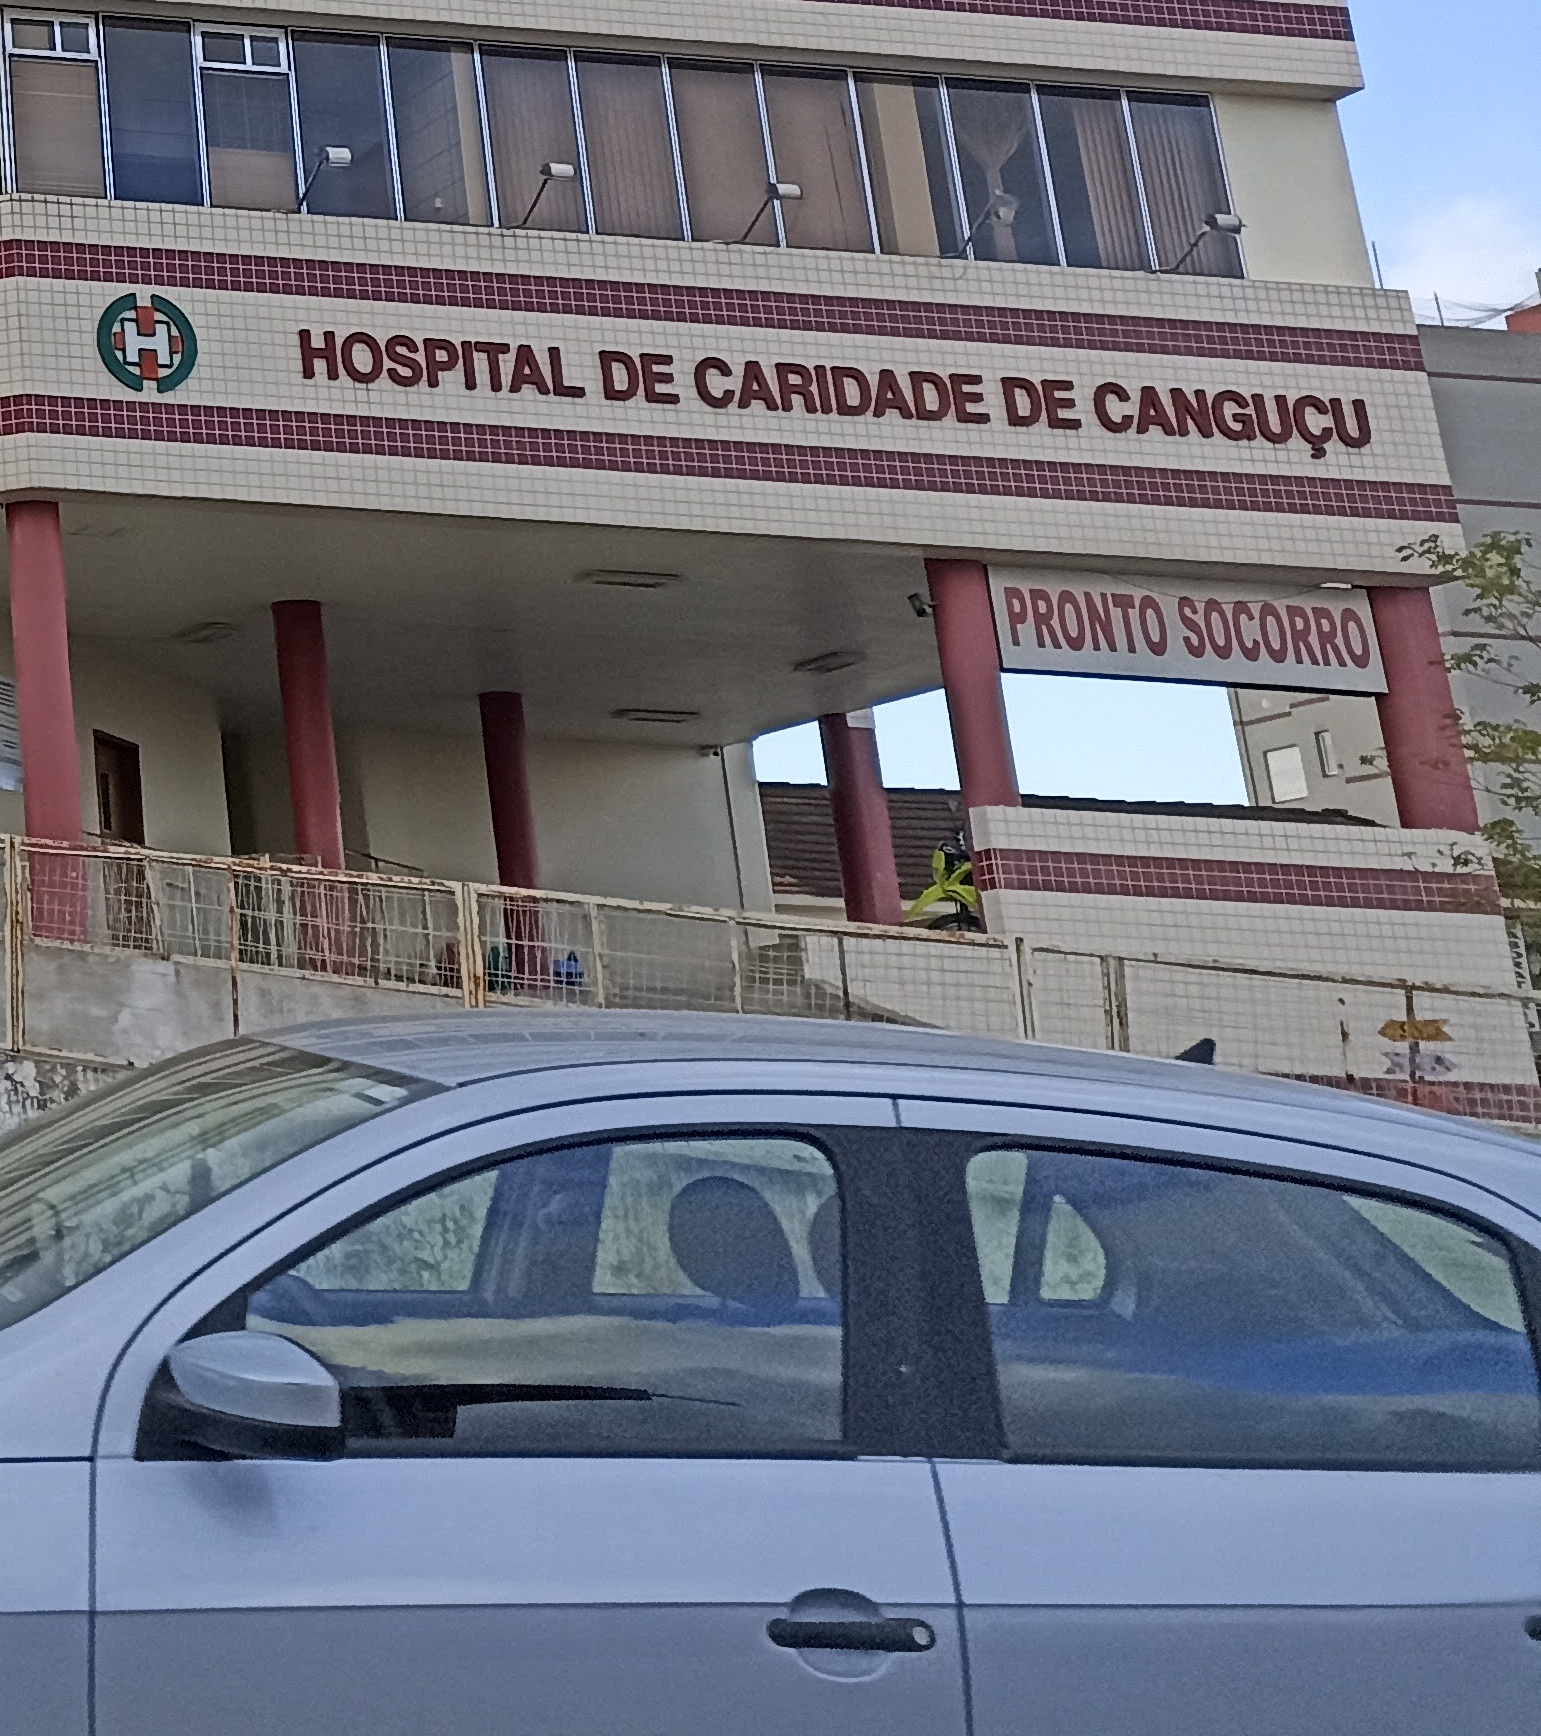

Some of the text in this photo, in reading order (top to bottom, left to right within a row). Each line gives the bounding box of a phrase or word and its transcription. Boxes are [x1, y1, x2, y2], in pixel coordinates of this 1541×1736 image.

[298, 328, 1372, 460] HOSPITAL DE CARIDADE DE CANGUÇU
[1003, 586, 1371, 670] PRONTO SOCORRO
